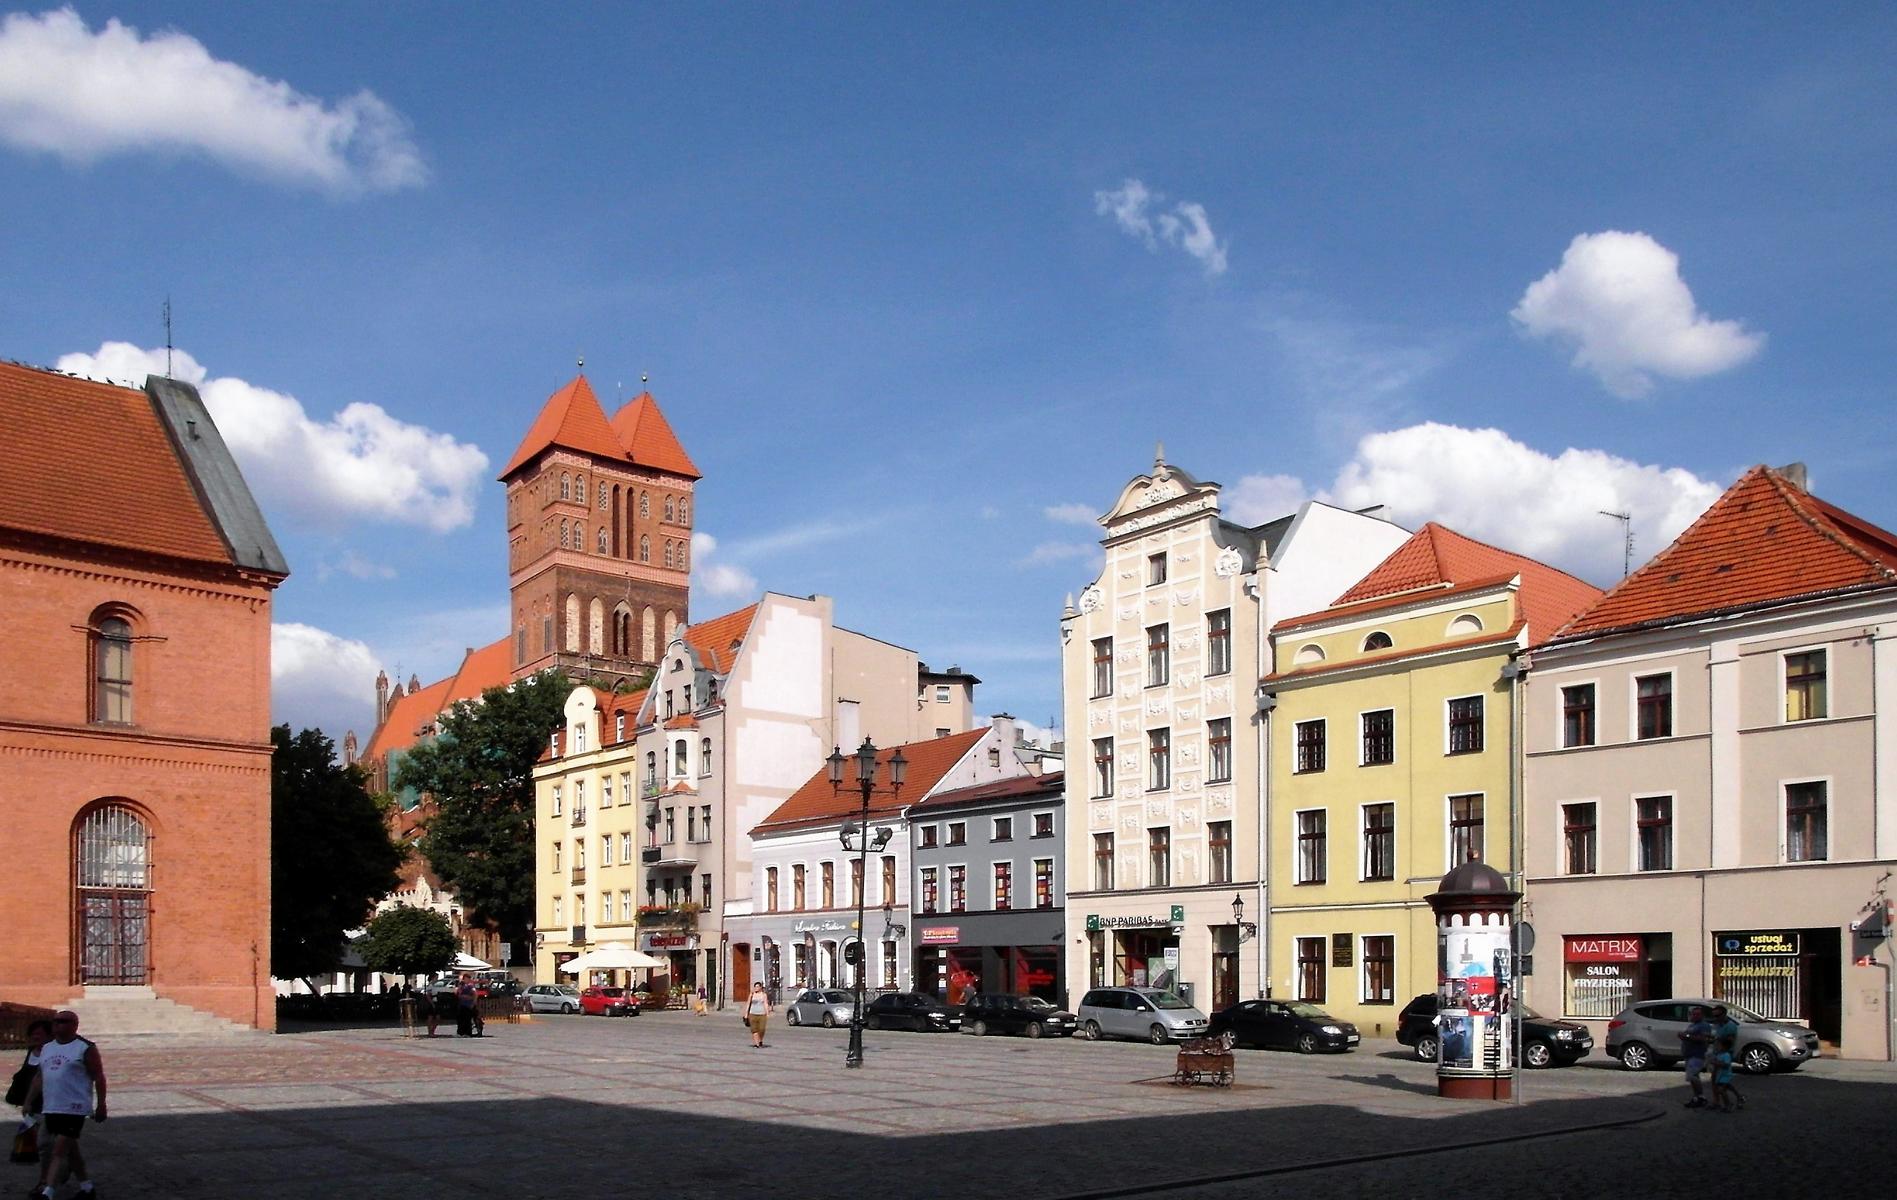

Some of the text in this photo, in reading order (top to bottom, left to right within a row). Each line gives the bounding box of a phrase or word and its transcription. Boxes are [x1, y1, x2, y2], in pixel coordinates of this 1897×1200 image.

[1100, 917, 1118, 926] BNP
[1119, 915, 1154, 926] PARIBAS
[1572, 940, 1638, 953] MATRIX
[1744, 943, 1793, 954] sprzedaż
[1586, 966, 1620, 976] SALON
[1720, 966, 1796, 977] ZEGARMISTRZ
[1574, 978, 1633, 988] FRYZJERSKI
